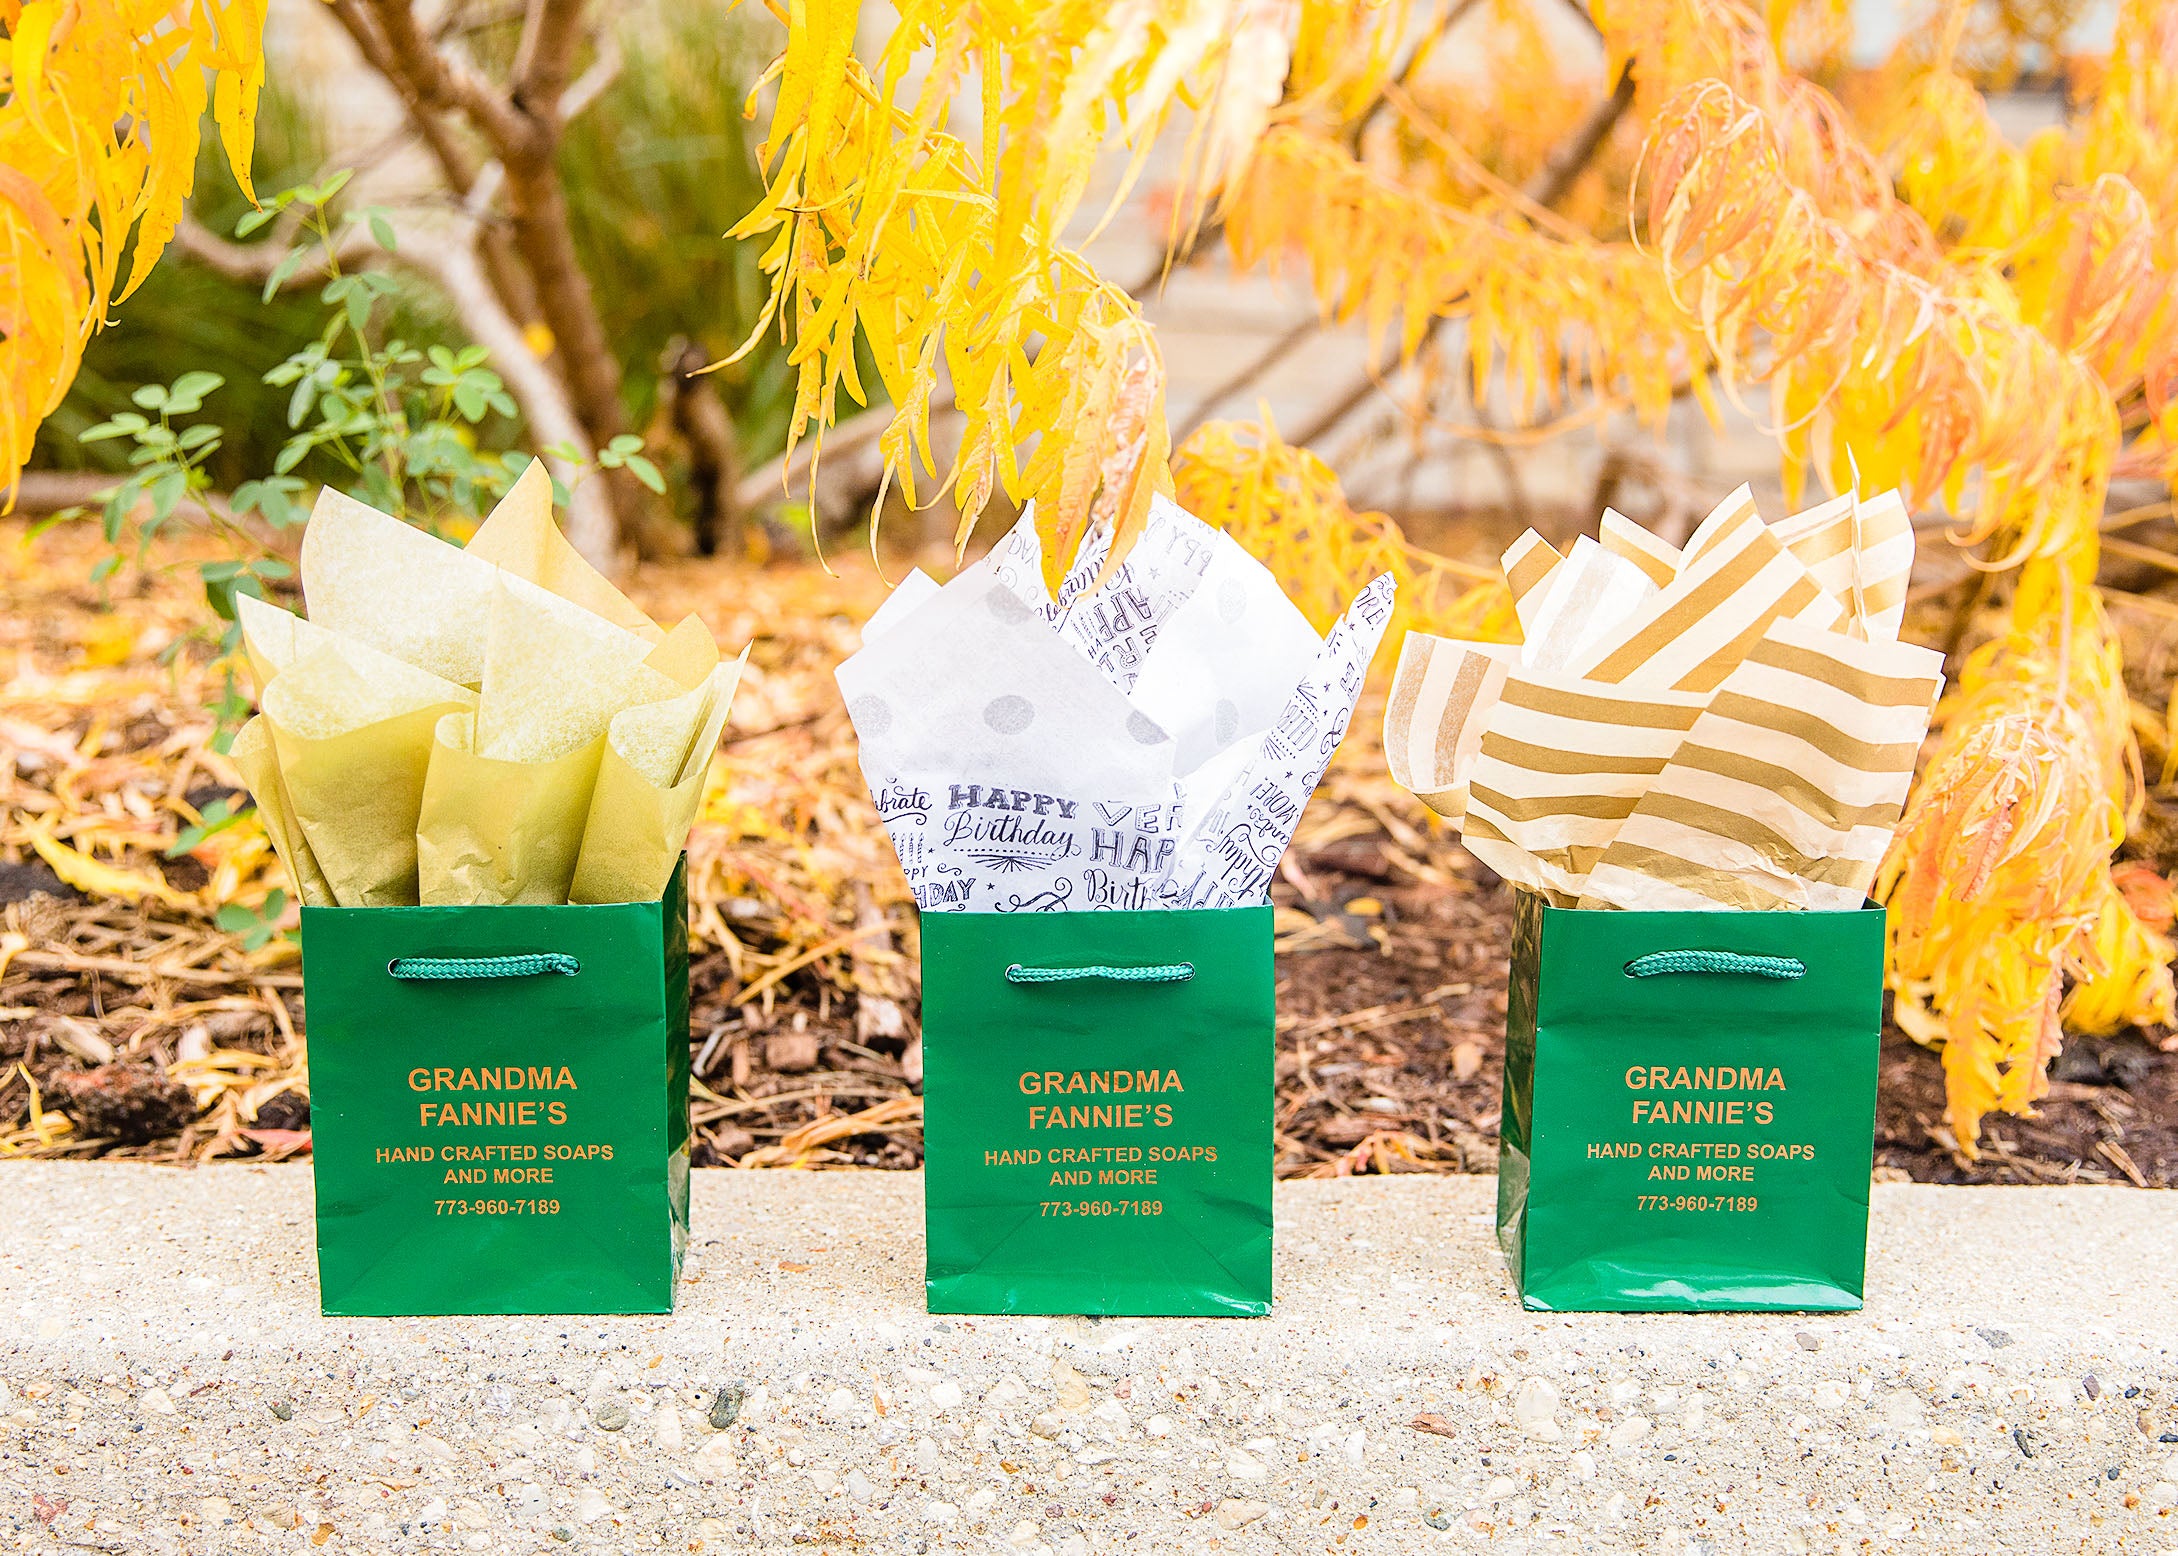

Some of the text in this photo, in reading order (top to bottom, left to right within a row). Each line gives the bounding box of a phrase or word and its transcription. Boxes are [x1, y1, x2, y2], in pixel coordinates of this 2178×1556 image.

[948, 784, 1079, 819] HAPPY
[943, 809, 1081, 861] Birthday
[407, 1066, 577, 1092] GRANDMA
[1019, 1069, 1184, 1095] GRANDMA
[1625, 1065, 1786, 1090] GRANDMA
[419, 1101, 567, 1127] FANNIE’S
[1029, 1103, 1173, 1129] FANNIE’S
[1632, 1100, 1774, 1125] FANNIE’S
[375, 1144, 614, 1163] HAND CRAFTED SOAPS
[985, 1146, 1217, 1165] HAND CRAFTED SOAPS
[1587, 1142, 1815, 1160] HAND CRAFTED SOAPS
[443, 1167, 553, 1184] AND MORE
[1049, 1169, 1157, 1186] AND MORE
[1648, 1165, 1754, 1181] AND MORE
[435, 1199, 560, 1215] 773-960-7189
[1040, 1200, 1163, 1216] 773-960-7189
[1638, 1195, 1758, 1211] 773-960-7189
